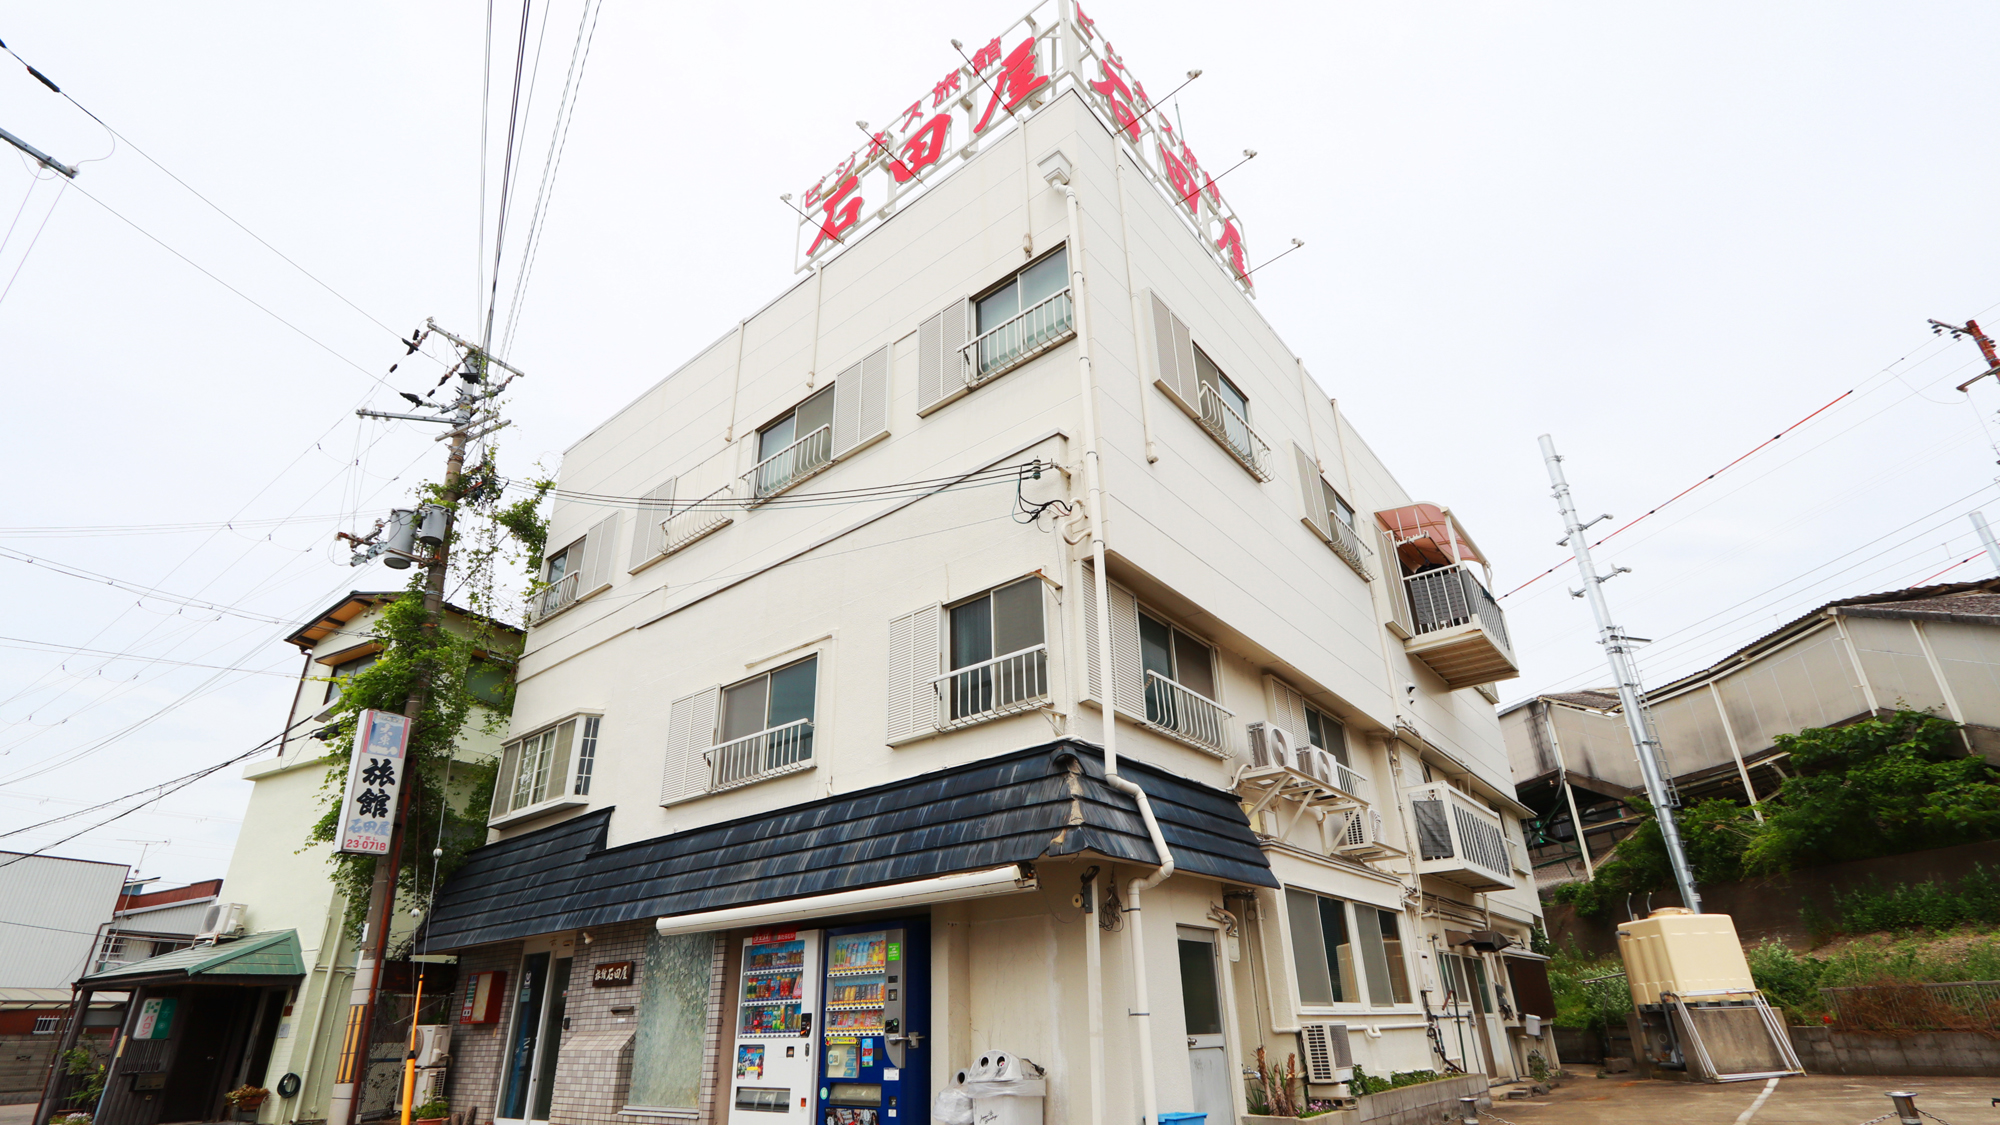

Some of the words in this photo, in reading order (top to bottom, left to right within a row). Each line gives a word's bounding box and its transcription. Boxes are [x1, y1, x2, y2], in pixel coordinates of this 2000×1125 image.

[805, 36, 1002, 209] ビジネス旅館
[806, 37, 1049, 257] 石田屋
[1090, 59, 1254, 289] 石田屋
[356, 758, 396, 819] 旅館
[346, 838, 387, 851] 23-0718
[347, 817, 391, 837] 石田屋
[140, 1015, 155, 1037] バロン
